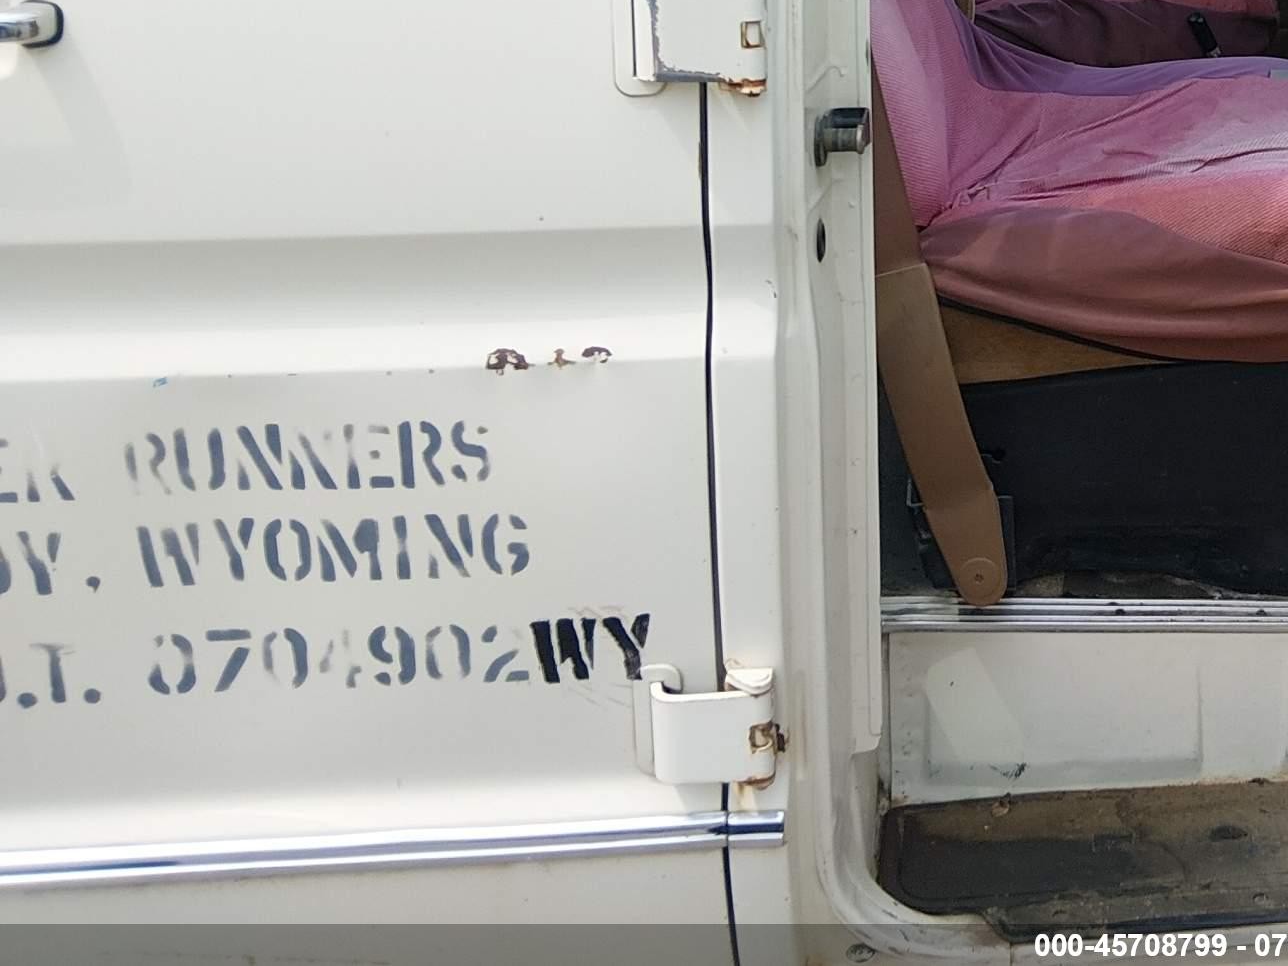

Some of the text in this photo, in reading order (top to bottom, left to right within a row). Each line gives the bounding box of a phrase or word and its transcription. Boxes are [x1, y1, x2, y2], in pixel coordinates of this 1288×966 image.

[125, 420, 491, 495] RUNNERS
[137, 513, 530, 588] WYOMING
[0, 642, 101, 710] .T.
